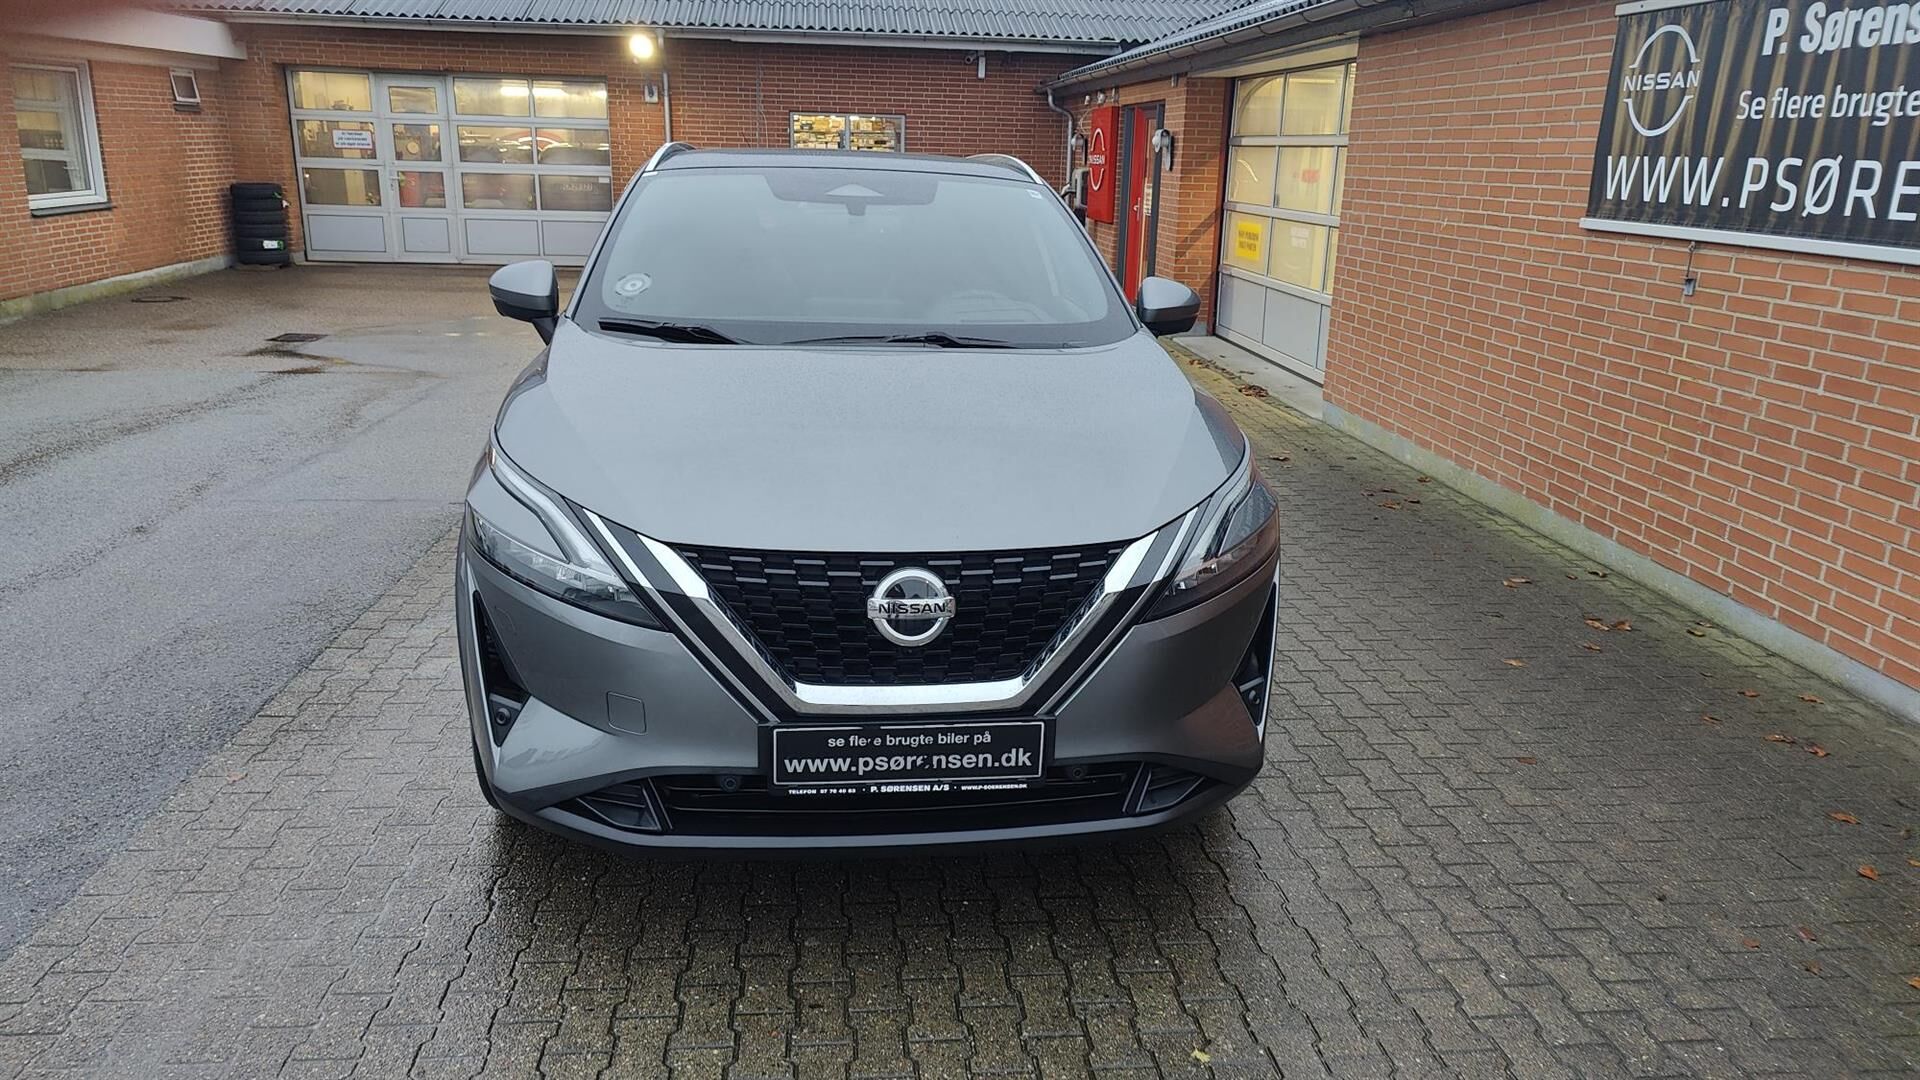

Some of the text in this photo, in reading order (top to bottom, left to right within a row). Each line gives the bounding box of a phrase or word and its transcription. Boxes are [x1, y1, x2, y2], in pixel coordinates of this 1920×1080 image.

[1762, 1, 1920, 56] P. Sørens
[1623, 70, 1700, 92] NISSAN
[1736, 84, 1920, 127] Se flere brugte
[1606, 154, 1920, 222] WWW.PSØRE
[878, 602, 946, 615] NISSAN
[827, 737, 846, 748] se
[886, 734, 934, 748] brugte
[938, 732, 970, 745] biler
[973, 730, 992, 746] på
[870, 785, 879, 793] P.
[880, 784, 931, 793] SØRENSEN
[932, 783, 950, 792] A/S
